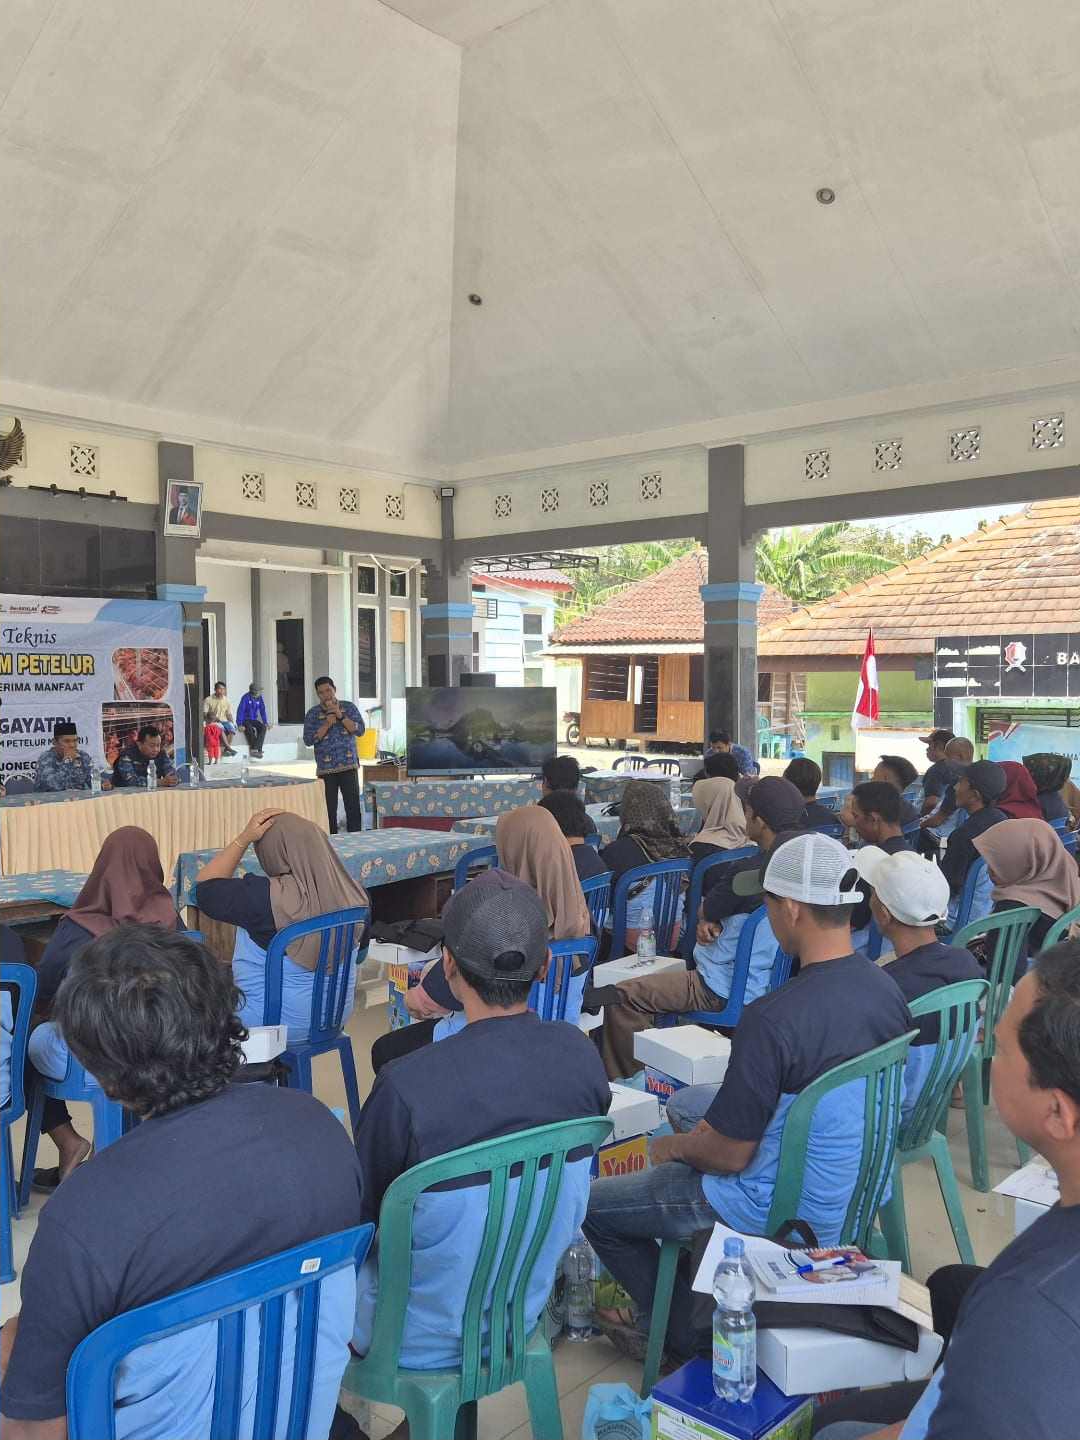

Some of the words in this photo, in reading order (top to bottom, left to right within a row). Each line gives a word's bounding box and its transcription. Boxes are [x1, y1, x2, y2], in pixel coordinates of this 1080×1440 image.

[3, 627, 57, 648] Teknis
[17, 653, 95, 676] PETELUR
[35, 682, 84, 692] MANFAAT
[6, 738, 48, 748] PETELUR
[603, 1152, 646, 1177] Yoto
